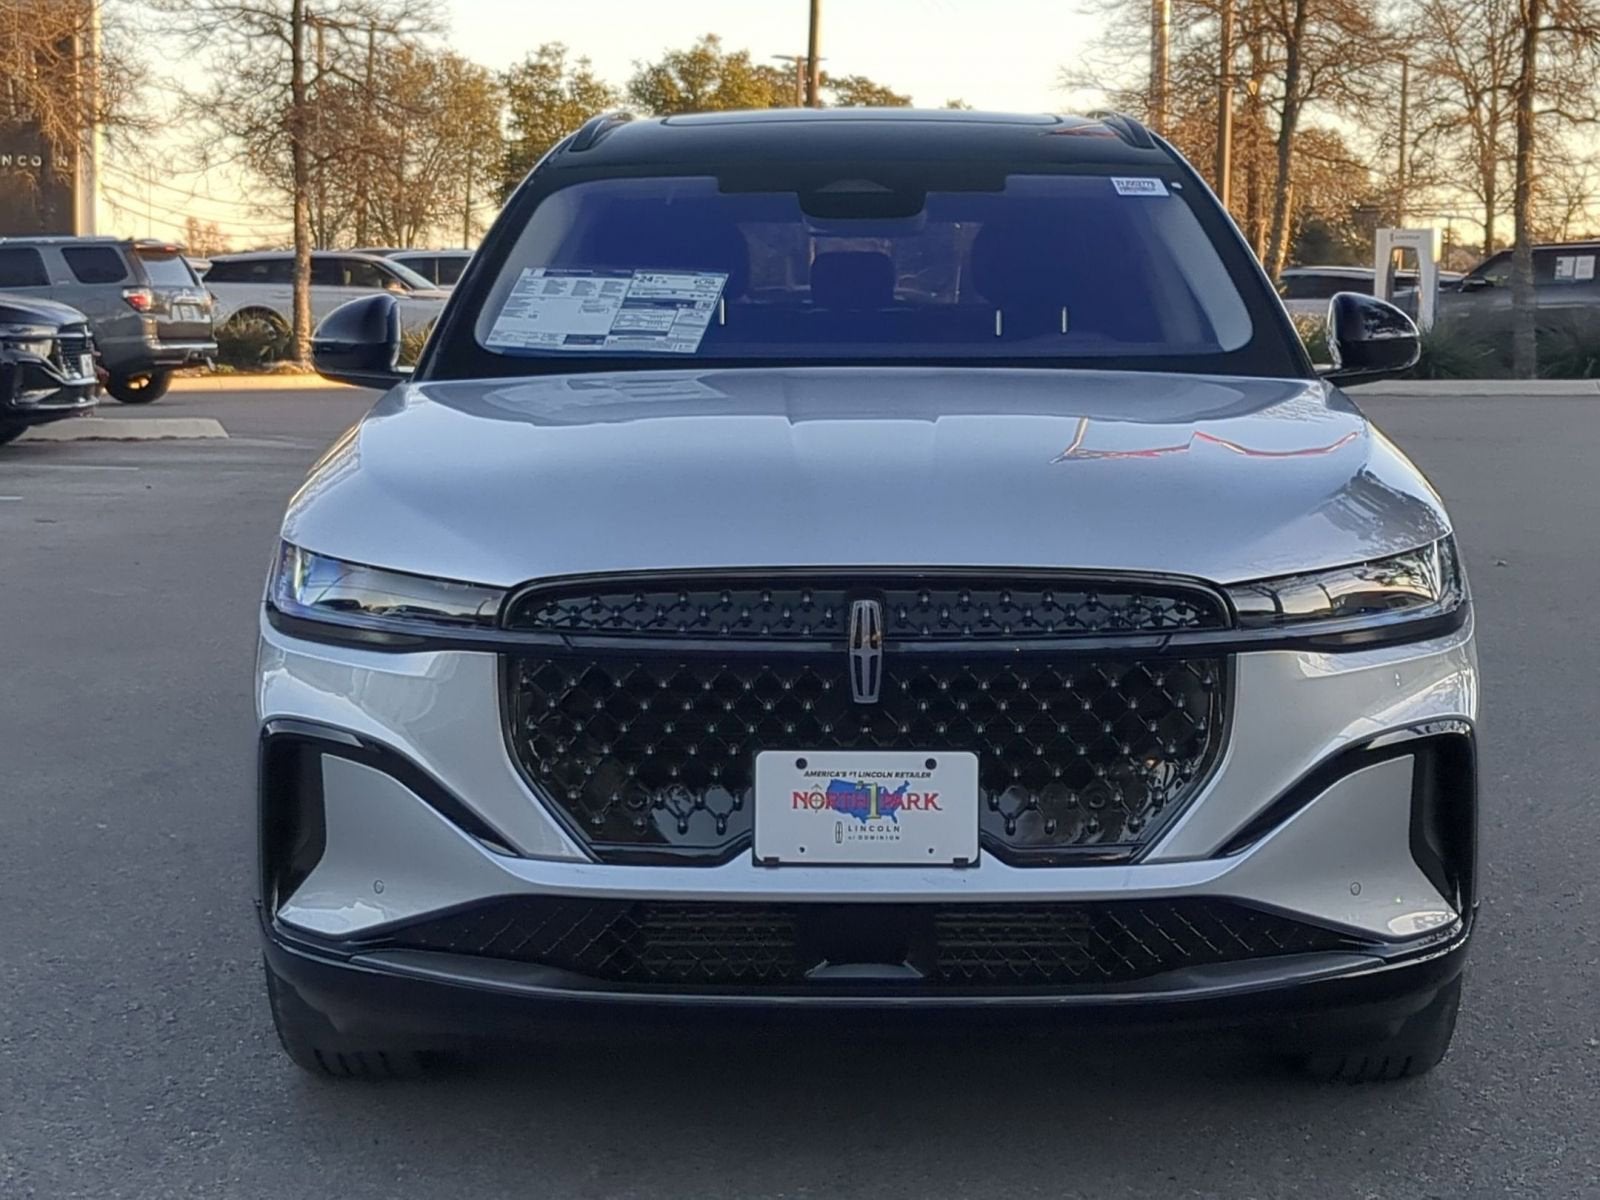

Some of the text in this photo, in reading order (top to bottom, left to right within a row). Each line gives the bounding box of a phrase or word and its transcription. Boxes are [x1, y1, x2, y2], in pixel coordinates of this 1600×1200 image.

[803, 770, 847, 778] AMERICA'S
[894, 771, 932, 779] RETAILER
[881, 792, 943, 811] PARK
